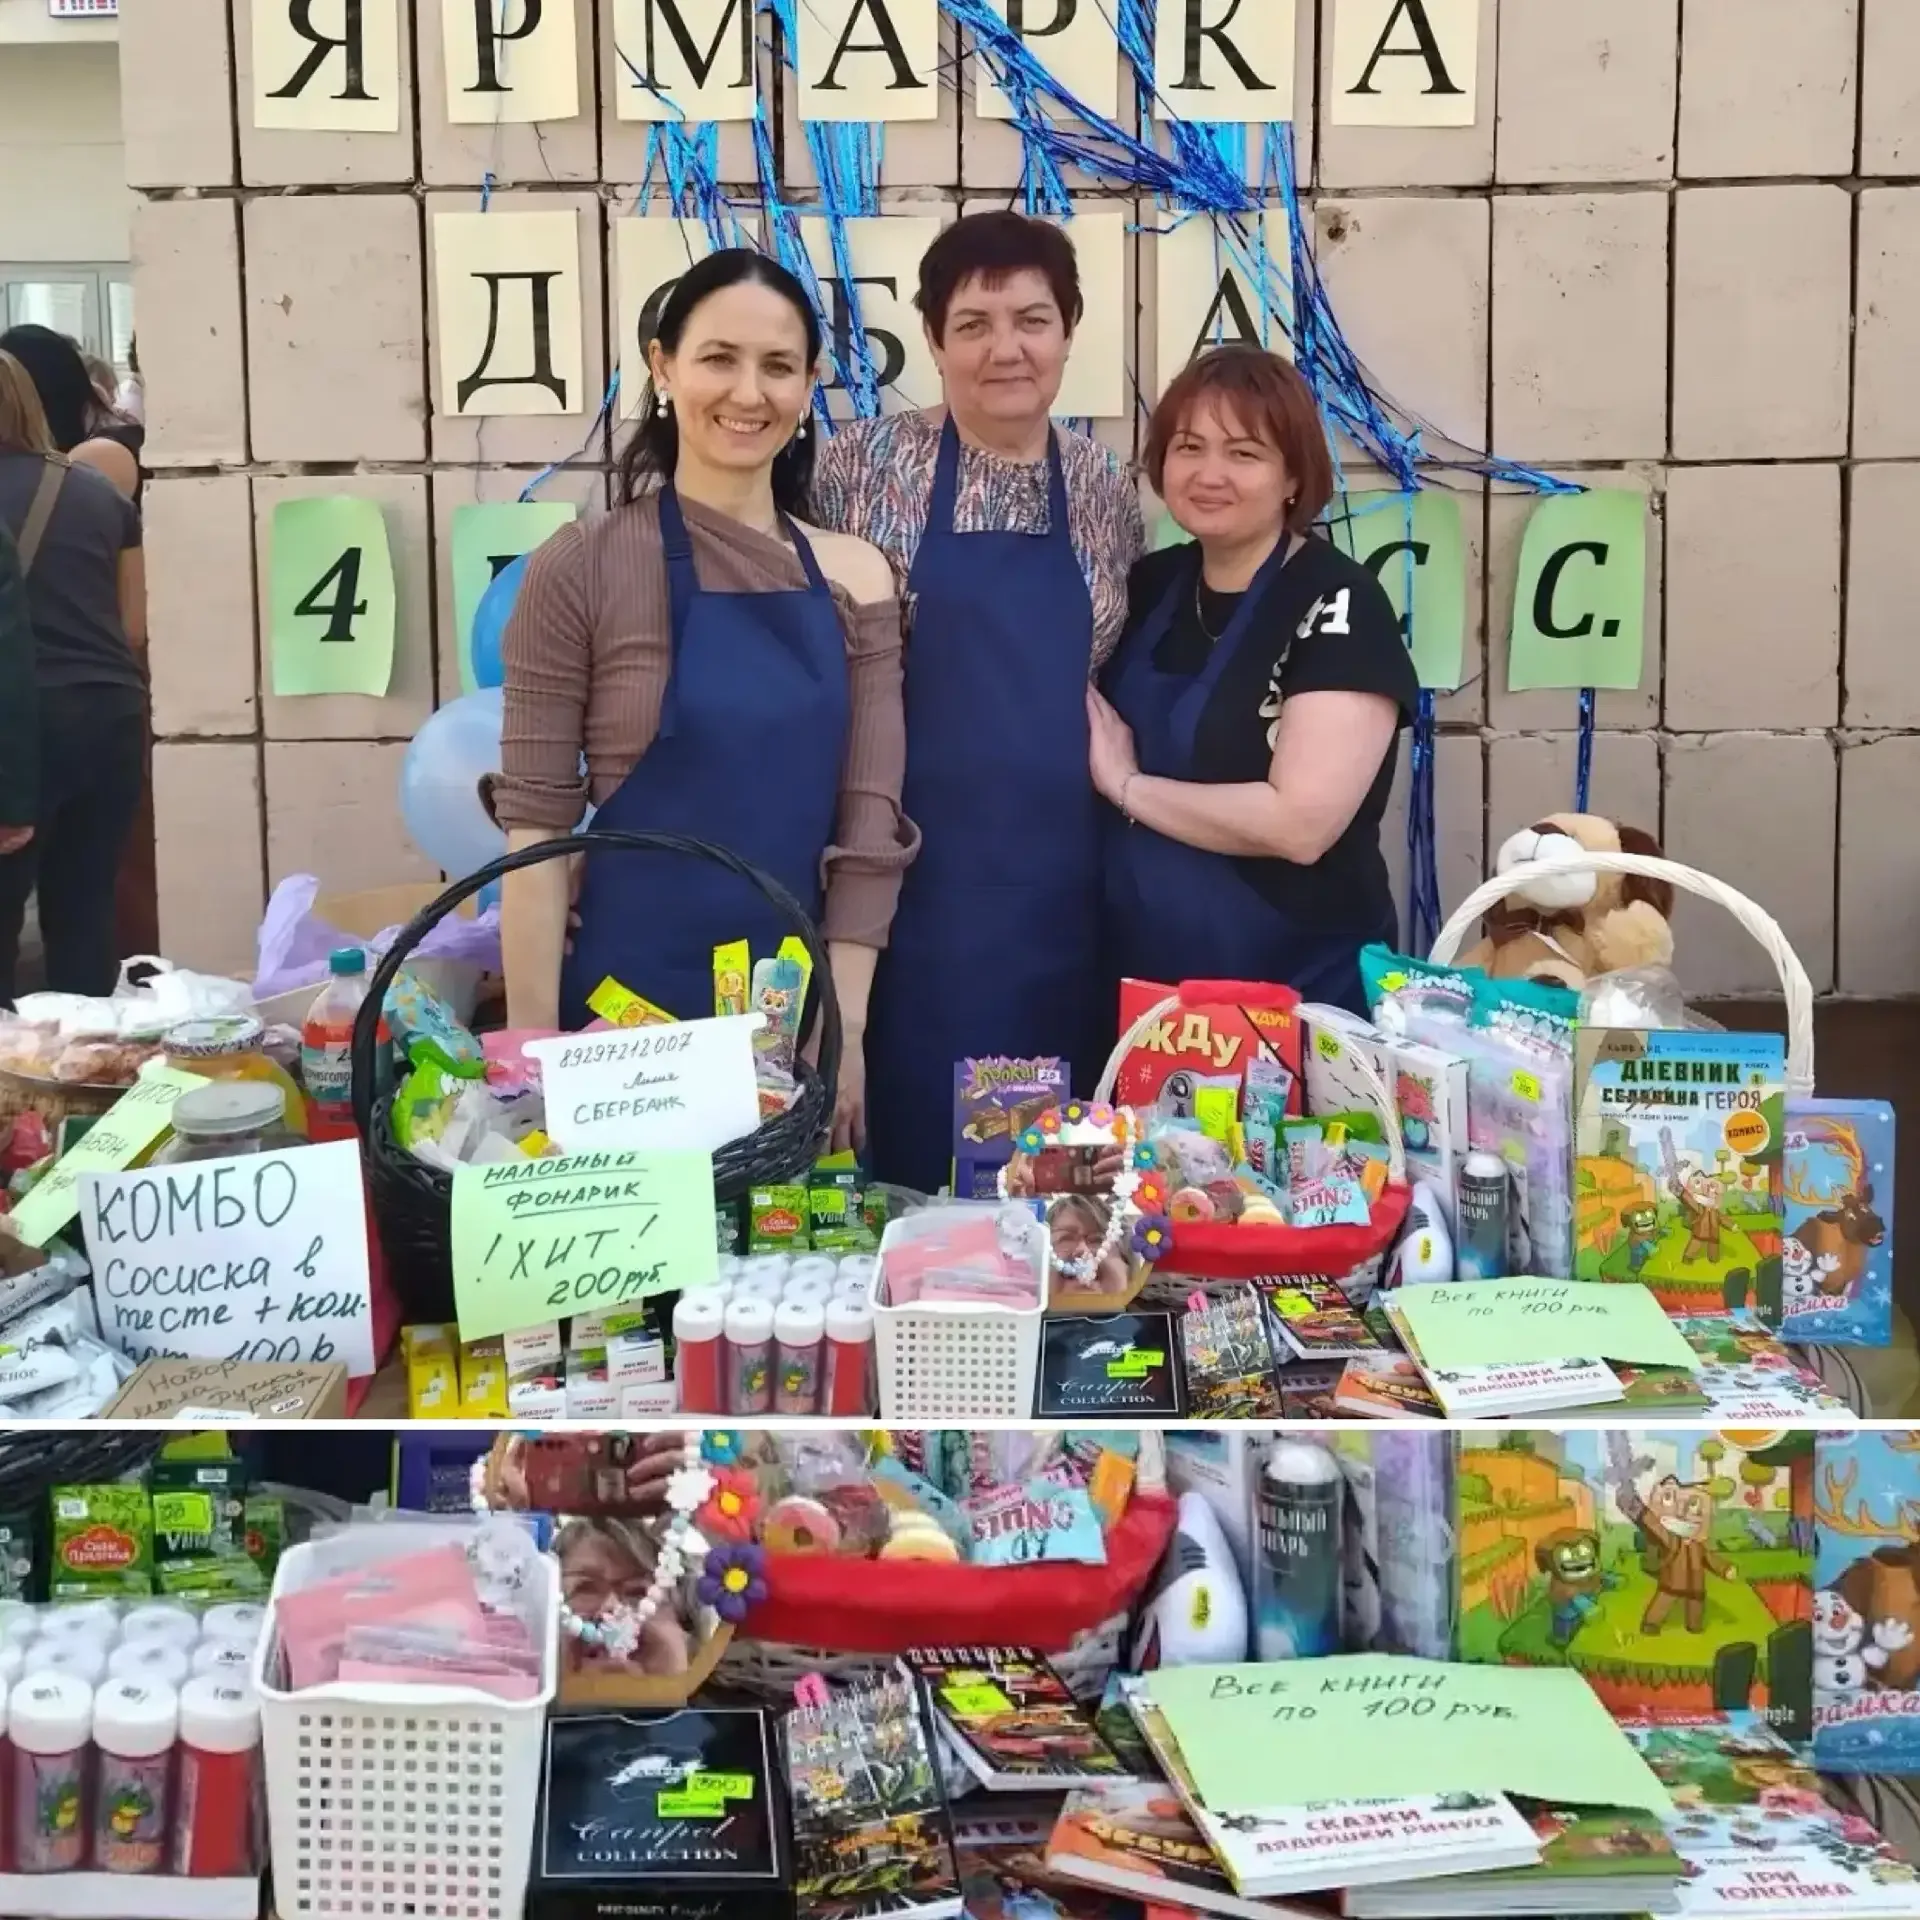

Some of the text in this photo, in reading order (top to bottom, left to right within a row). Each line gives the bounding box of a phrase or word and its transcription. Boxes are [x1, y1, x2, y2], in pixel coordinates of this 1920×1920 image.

[293, 546, 368, 642] 4
[560, 1031, 694, 1068] 89297212007
[1621, 1060, 1741, 1085] ДНЕВНИК
[573, 1096, 686, 1125] СБЕРБАНК
[1705, 1089, 1763, 1111] ГЕРОЯ
[484, 1151, 639, 1184] НАЛОБНЫЙ
[94, 1160, 297, 1243] КОМБО
[506, 1181, 641, 1212] ФОНАРИК
[106, 1235, 323, 1298] Сосиска в
[509, 1229, 619, 1281] ХИТ
[546, 1267, 620, 1305] 200
[1521, 1300, 1564, 1315] 100
[1060, 1395, 1156, 1406] COLLECTION
[1362, 1696, 1437, 1718] 100
[1304, 1808, 1423, 1832] СКАЗКИ
[577, 1848, 739, 1863] COLLECTION
